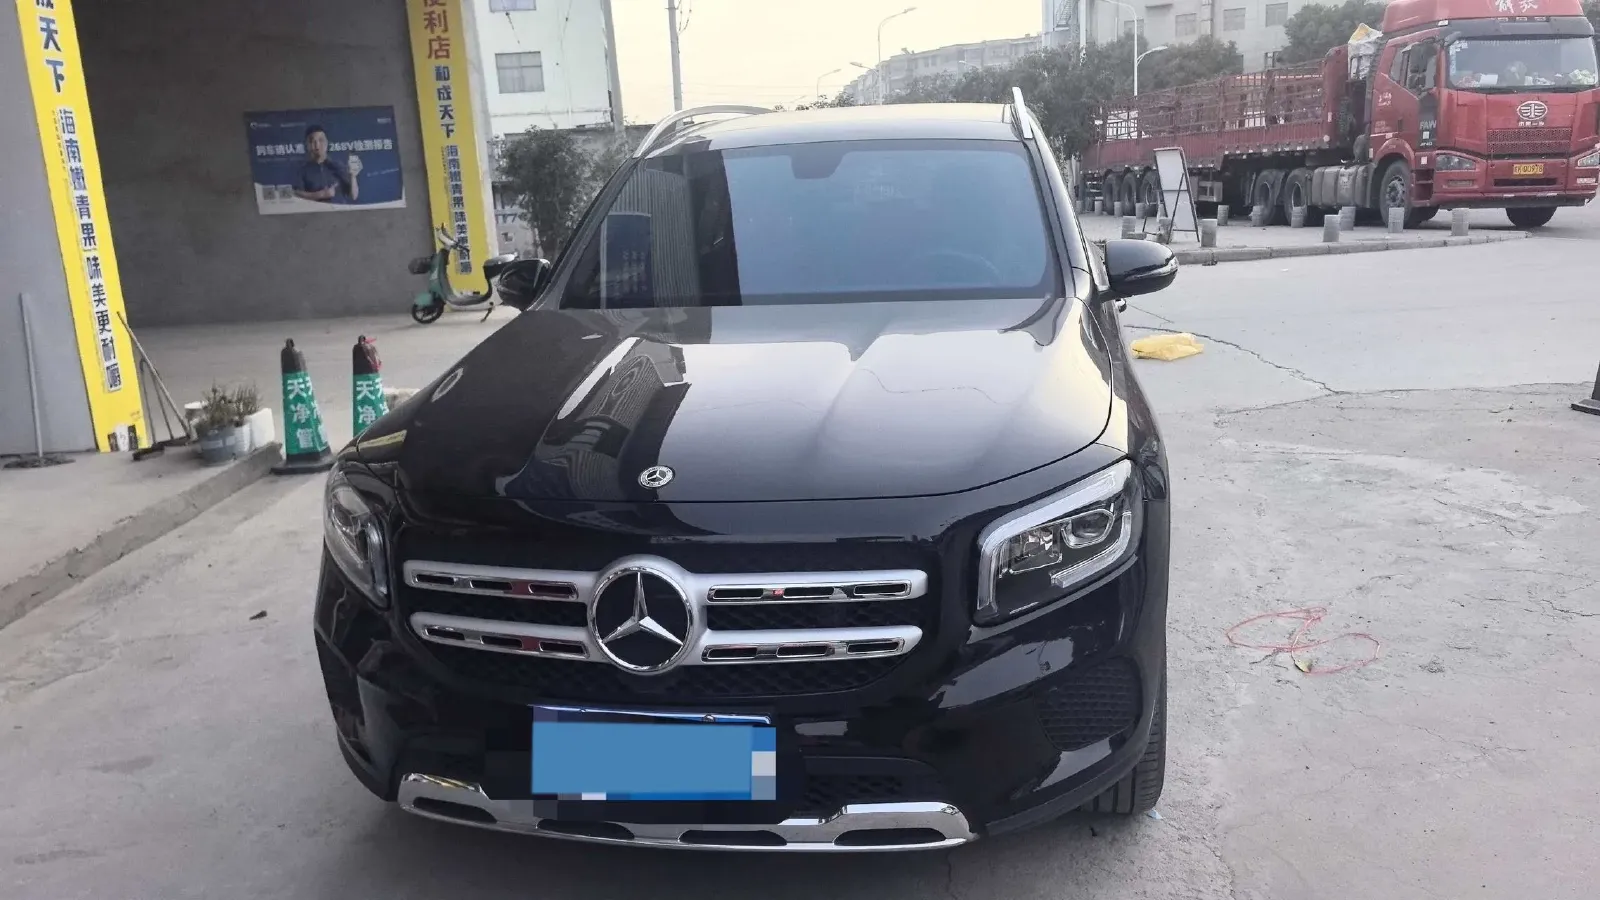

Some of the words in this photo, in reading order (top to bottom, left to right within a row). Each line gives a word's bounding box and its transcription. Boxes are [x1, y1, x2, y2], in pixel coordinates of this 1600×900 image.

[35, 0, 65, 93] 天下
[435, 65, 455, 139] 和成天下
[1420, 120, 1437, 130] FAW
